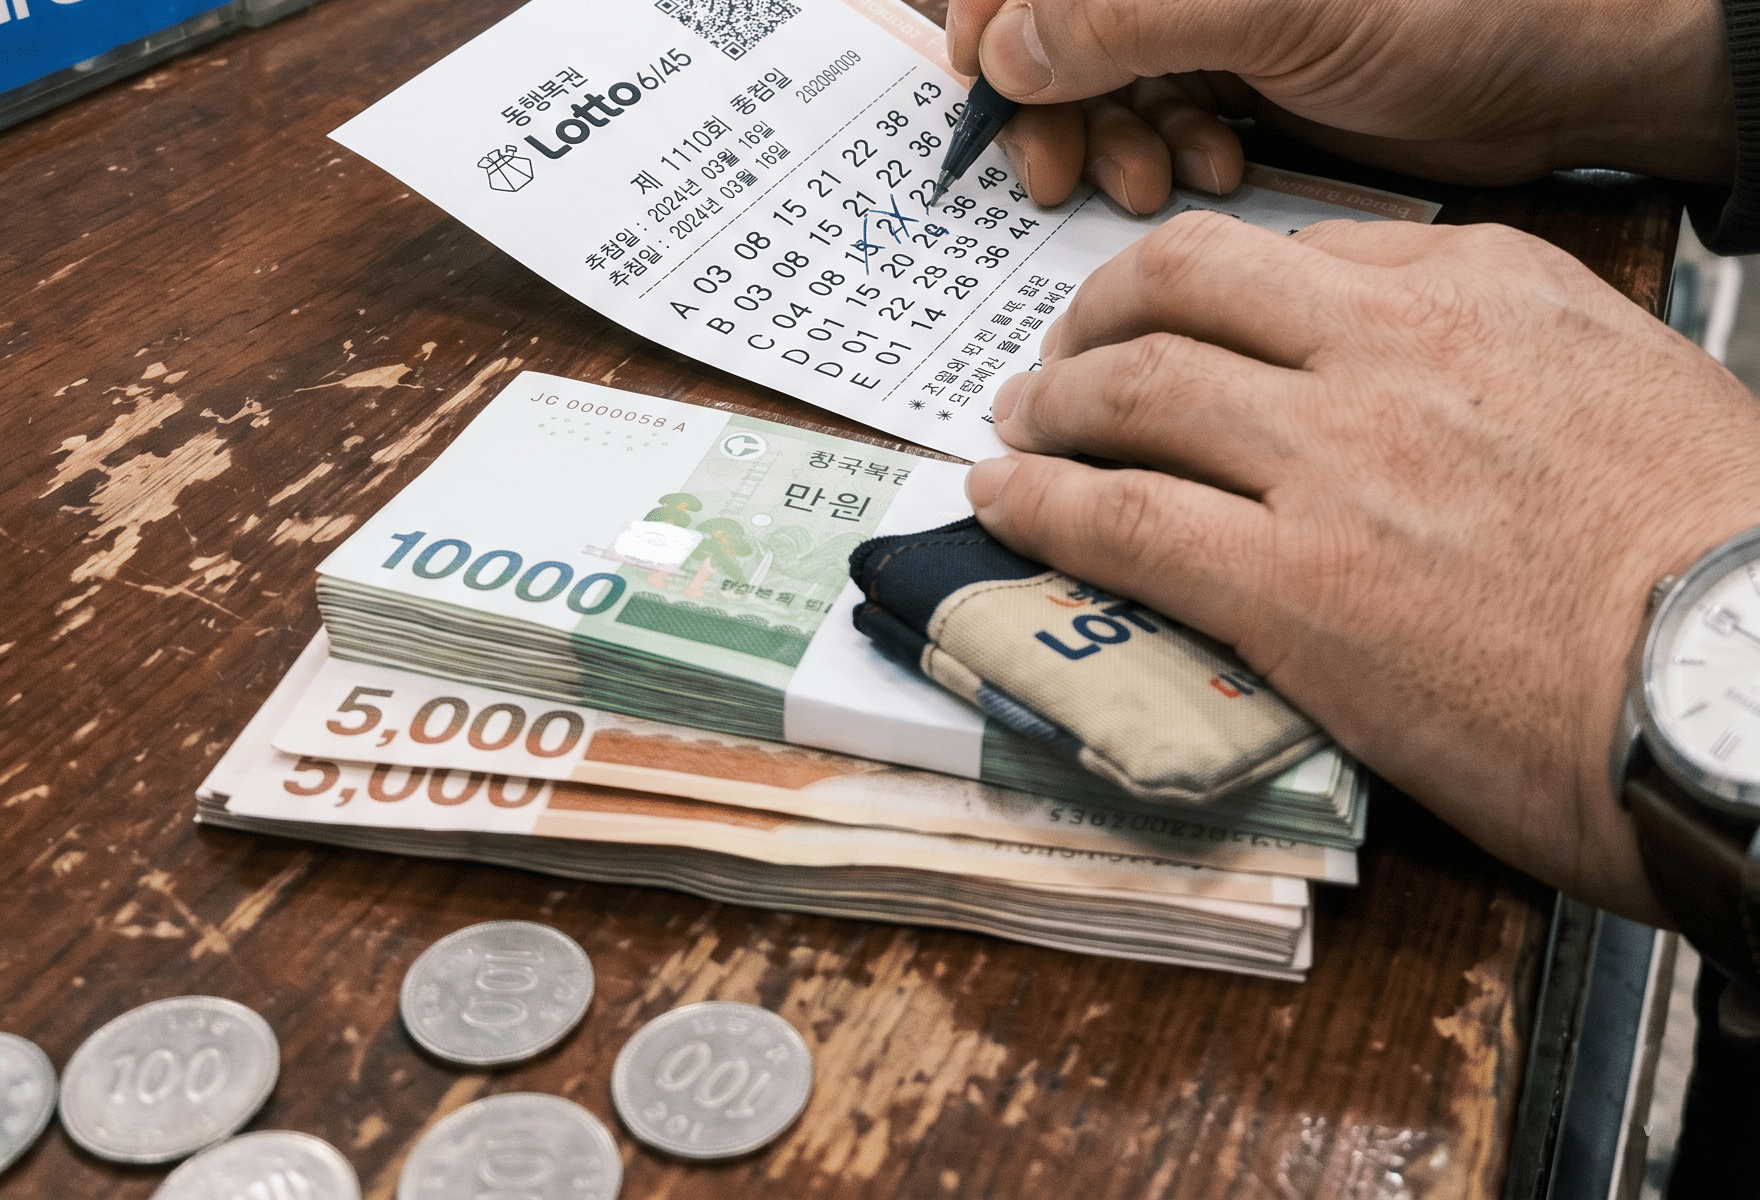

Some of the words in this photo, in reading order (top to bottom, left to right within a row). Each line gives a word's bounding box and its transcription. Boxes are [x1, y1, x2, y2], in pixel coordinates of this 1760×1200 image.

[501, 66, 588, 127] 동행복권
[523, 81, 642, 160] Lotto
[630, 168, 664, 195] 제
[660, 115, 733, 172] 1110회
[647, 177, 704, 223] 2024년
[738, 120, 776, 152] 16일
[669, 196, 724, 241] 2024년
[754, 141, 791, 173] 16일
[670, 302, 699, 319] A
[693, 265, 732, 294] 03
[734, 232, 771, 260] 08
[773, 199, 807, 225] 15
[808, 170, 842, 198] 21
[842, 140, 878, 168] 22
[876, 110, 909, 137] 38
[914, 81, 942, 107] 43
[706, 317, 735, 335] B
[734, 285, 772, 311] 03
[773, 251, 809, 279] 08
[809, 218, 843, 246] 15
[843, 191, 876, 217] 21
[876, 160, 912, 188] 22
[909, 130, 942, 158] 36
[781, 348, 809, 365] D
[807, 318, 845, 341] 01
[846, 284, 881, 308] 15
[880, 254, 914, 278] 20
[943, 195, 977, 219] 36
[978, 166, 1008, 190] 48
[814, 361, 844, 379] D
[842, 331, 879, 354] 01
[879, 296, 915, 321] 22
[913, 265, 948, 290] 28
[944, 236, 979, 258] 38
[975, 207, 1009, 230] 36
[850, 372, 881, 390] E
[876, 340, 912, 365] 01
[911, 308, 947, 330] 14
[944, 275, 979, 300] 26
[975, 246, 1009, 269] 36
[1009, 217, 1040, 240] 44
[748, 334, 776, 350] C
[772, 302, 813, 329] 04
[809, 270, 845, 295] 08
[566, 399, 667, 428] 0000058
[381, 530, 627, 615] 10000
[326, 685, 585, 758] 5,000
[107, 1048, 228, 1104] 100
